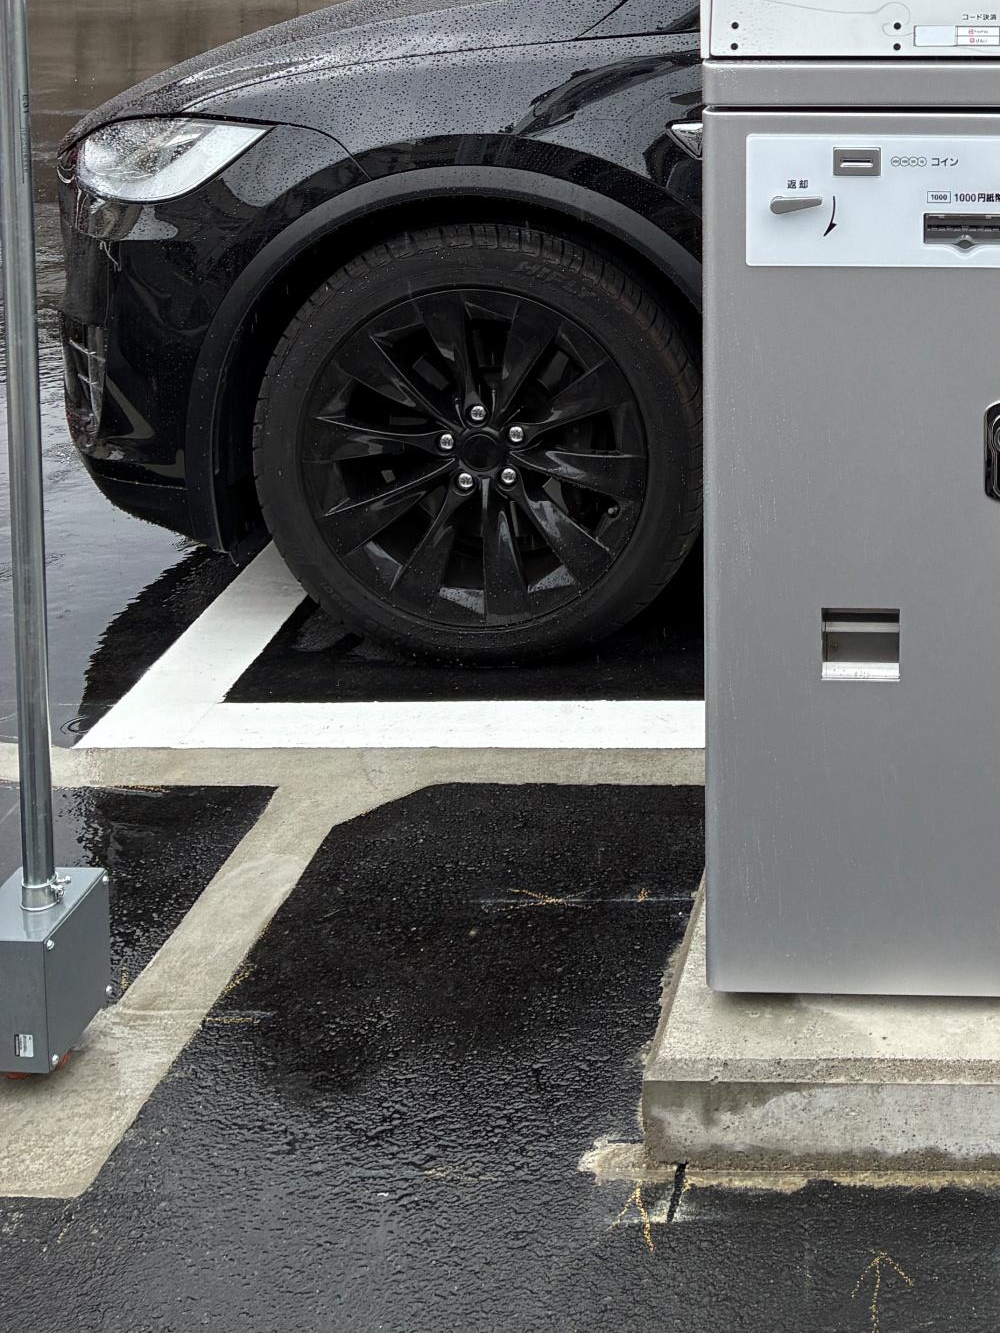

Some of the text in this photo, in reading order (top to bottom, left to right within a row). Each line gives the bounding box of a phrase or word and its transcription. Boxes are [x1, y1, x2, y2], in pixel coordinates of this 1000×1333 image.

[962, 13, 997, 21] コード決済
[931, 157, 959, 166] コイン
[787, 179, 809, 189] 返却
